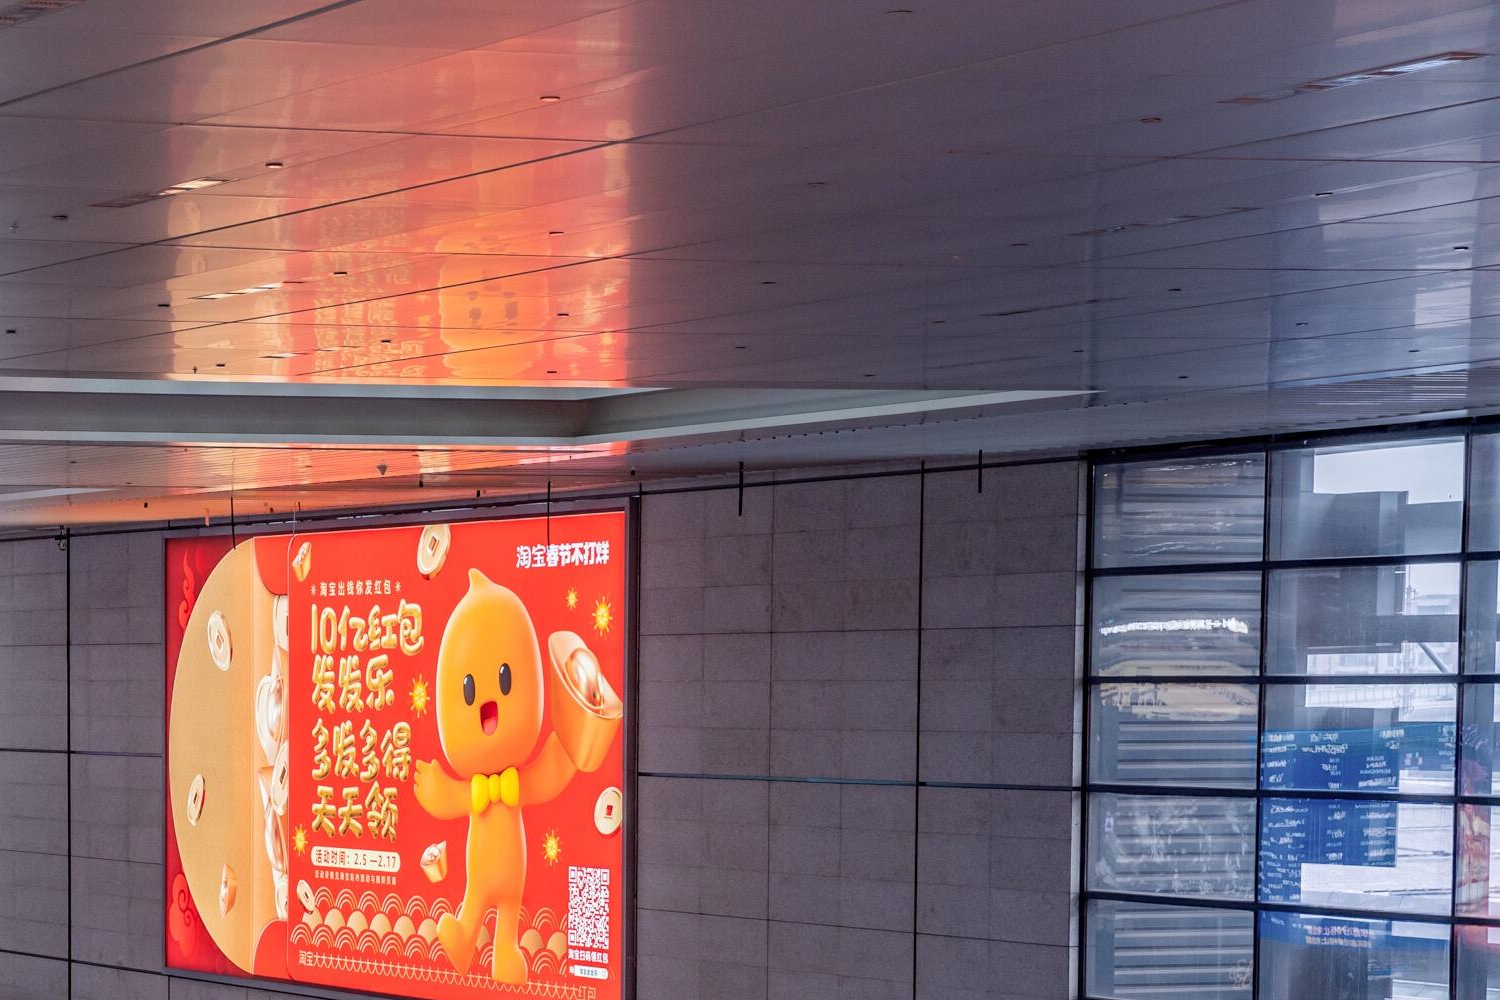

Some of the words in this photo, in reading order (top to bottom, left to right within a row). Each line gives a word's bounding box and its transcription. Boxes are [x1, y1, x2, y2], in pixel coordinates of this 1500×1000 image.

[516, 541, 610, 568] 淘宝春节不打烊
[311, 599, 425, 656] 10亿红包
[312, 654, 395, 713] 发发乐
[311, 718, 412, 783] 多发多得
[311, 782, 399, 842] 天天领
